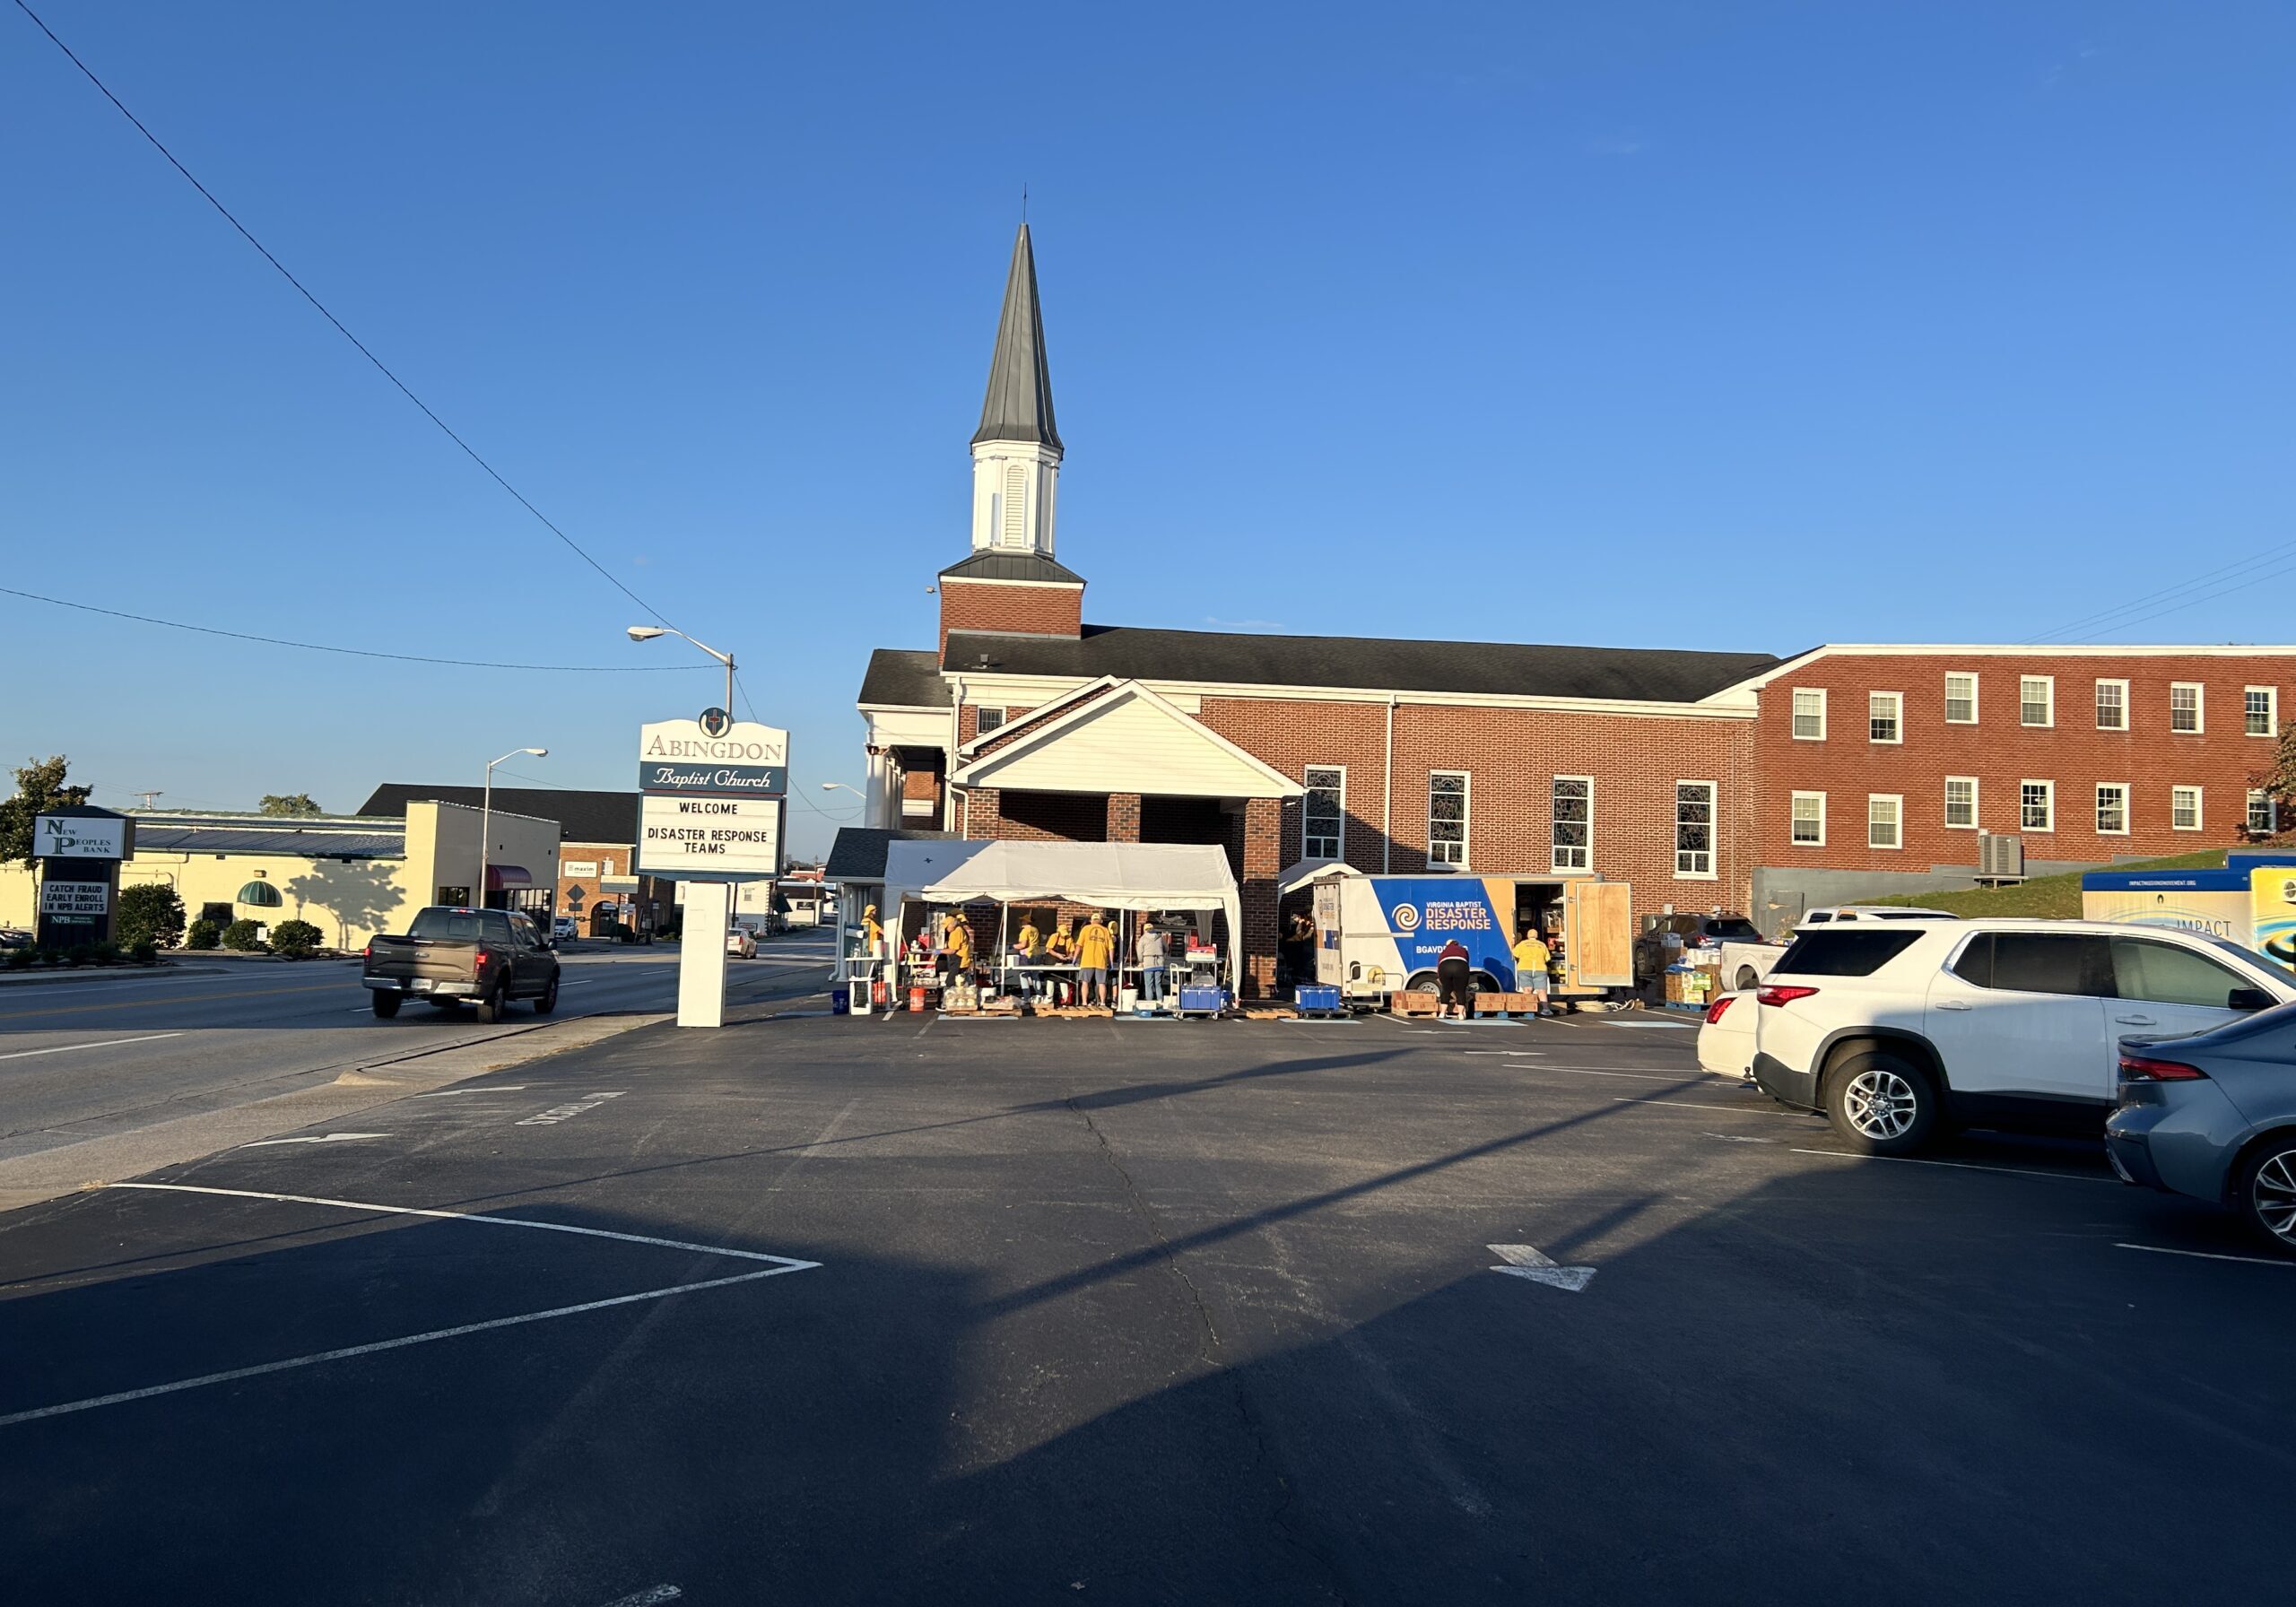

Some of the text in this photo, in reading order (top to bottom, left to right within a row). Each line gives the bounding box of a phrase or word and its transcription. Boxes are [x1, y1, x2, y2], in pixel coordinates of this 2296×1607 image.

[646, 734, 783, 760] ABINGDON
[653, 767, 771, 788] Baptist Church
[679, 802, 738, 815] WELCOME
[648, 827, 767, 842] DISASTER RESPONSE
[684, 842, 726, 855] TEAMS
[49, 884, 102, 893] CATCH FRAUD
[47, 894, 104, 902] EARLY ENROLL
[44, 902, 104, 912] IN NPB ALERTS
[1426, 908, 1487, 919] DISASTER
[51, 916, 71, 924] NPB
[1426, 919, 1492, 930] RESPONSE
[2177, 920, 2231, 937] IMPACT
